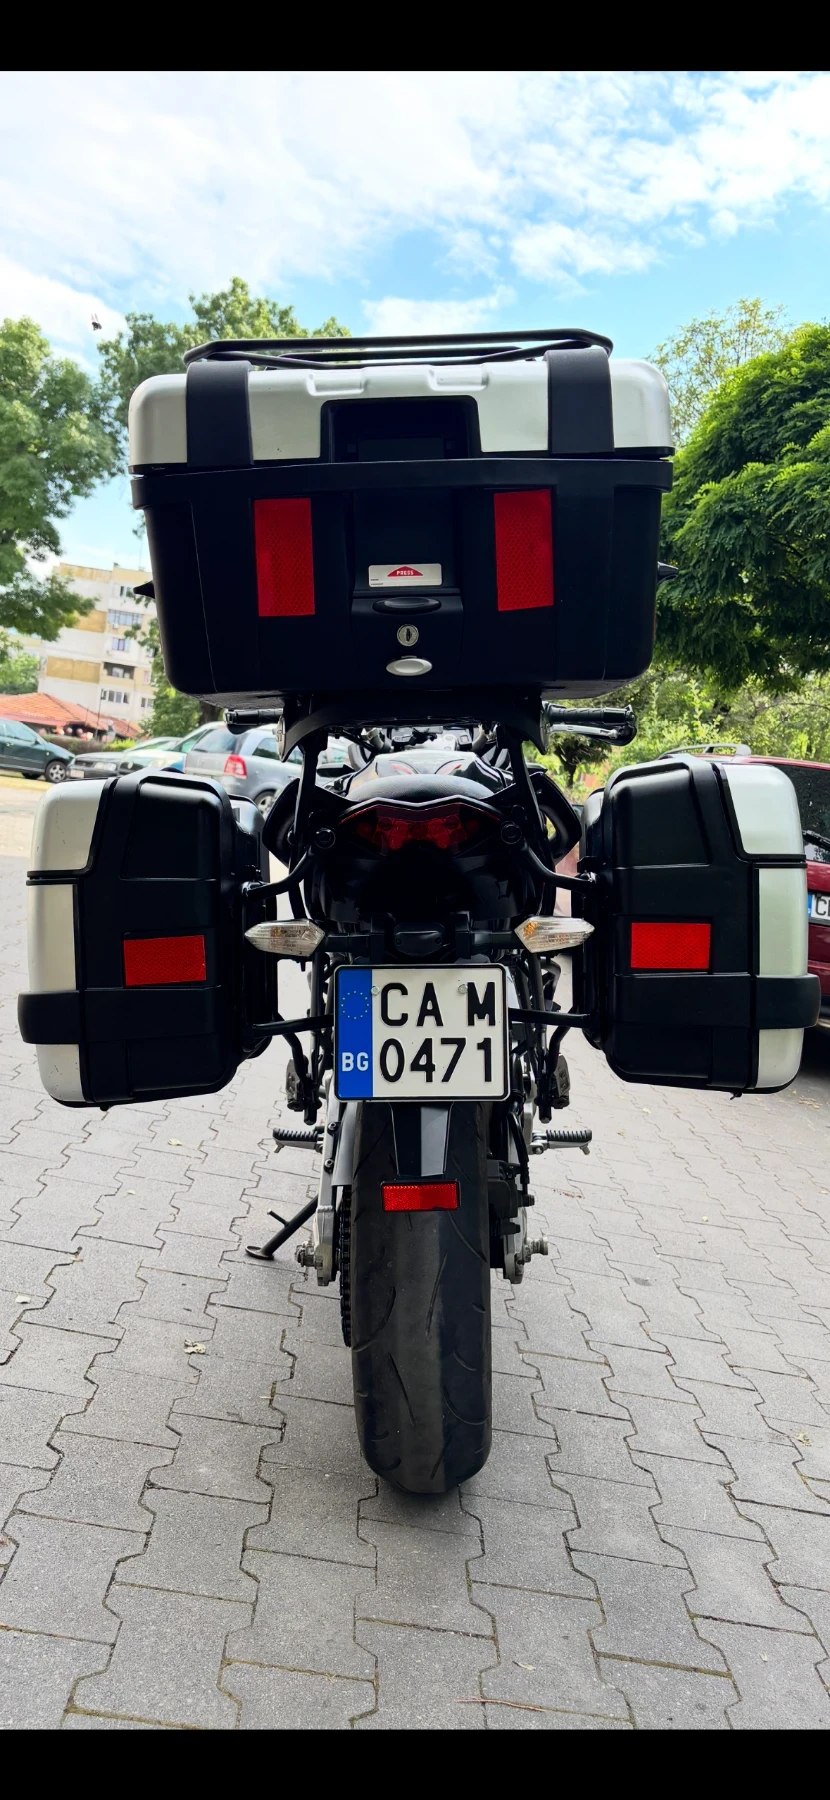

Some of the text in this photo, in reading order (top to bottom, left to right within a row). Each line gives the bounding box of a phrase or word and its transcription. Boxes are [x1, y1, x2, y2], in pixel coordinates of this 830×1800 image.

[380, 981, 496, 1027] CA M
[341, 1051, 369, 1072] BG
[379, 1037, 492, 1083] 0471
